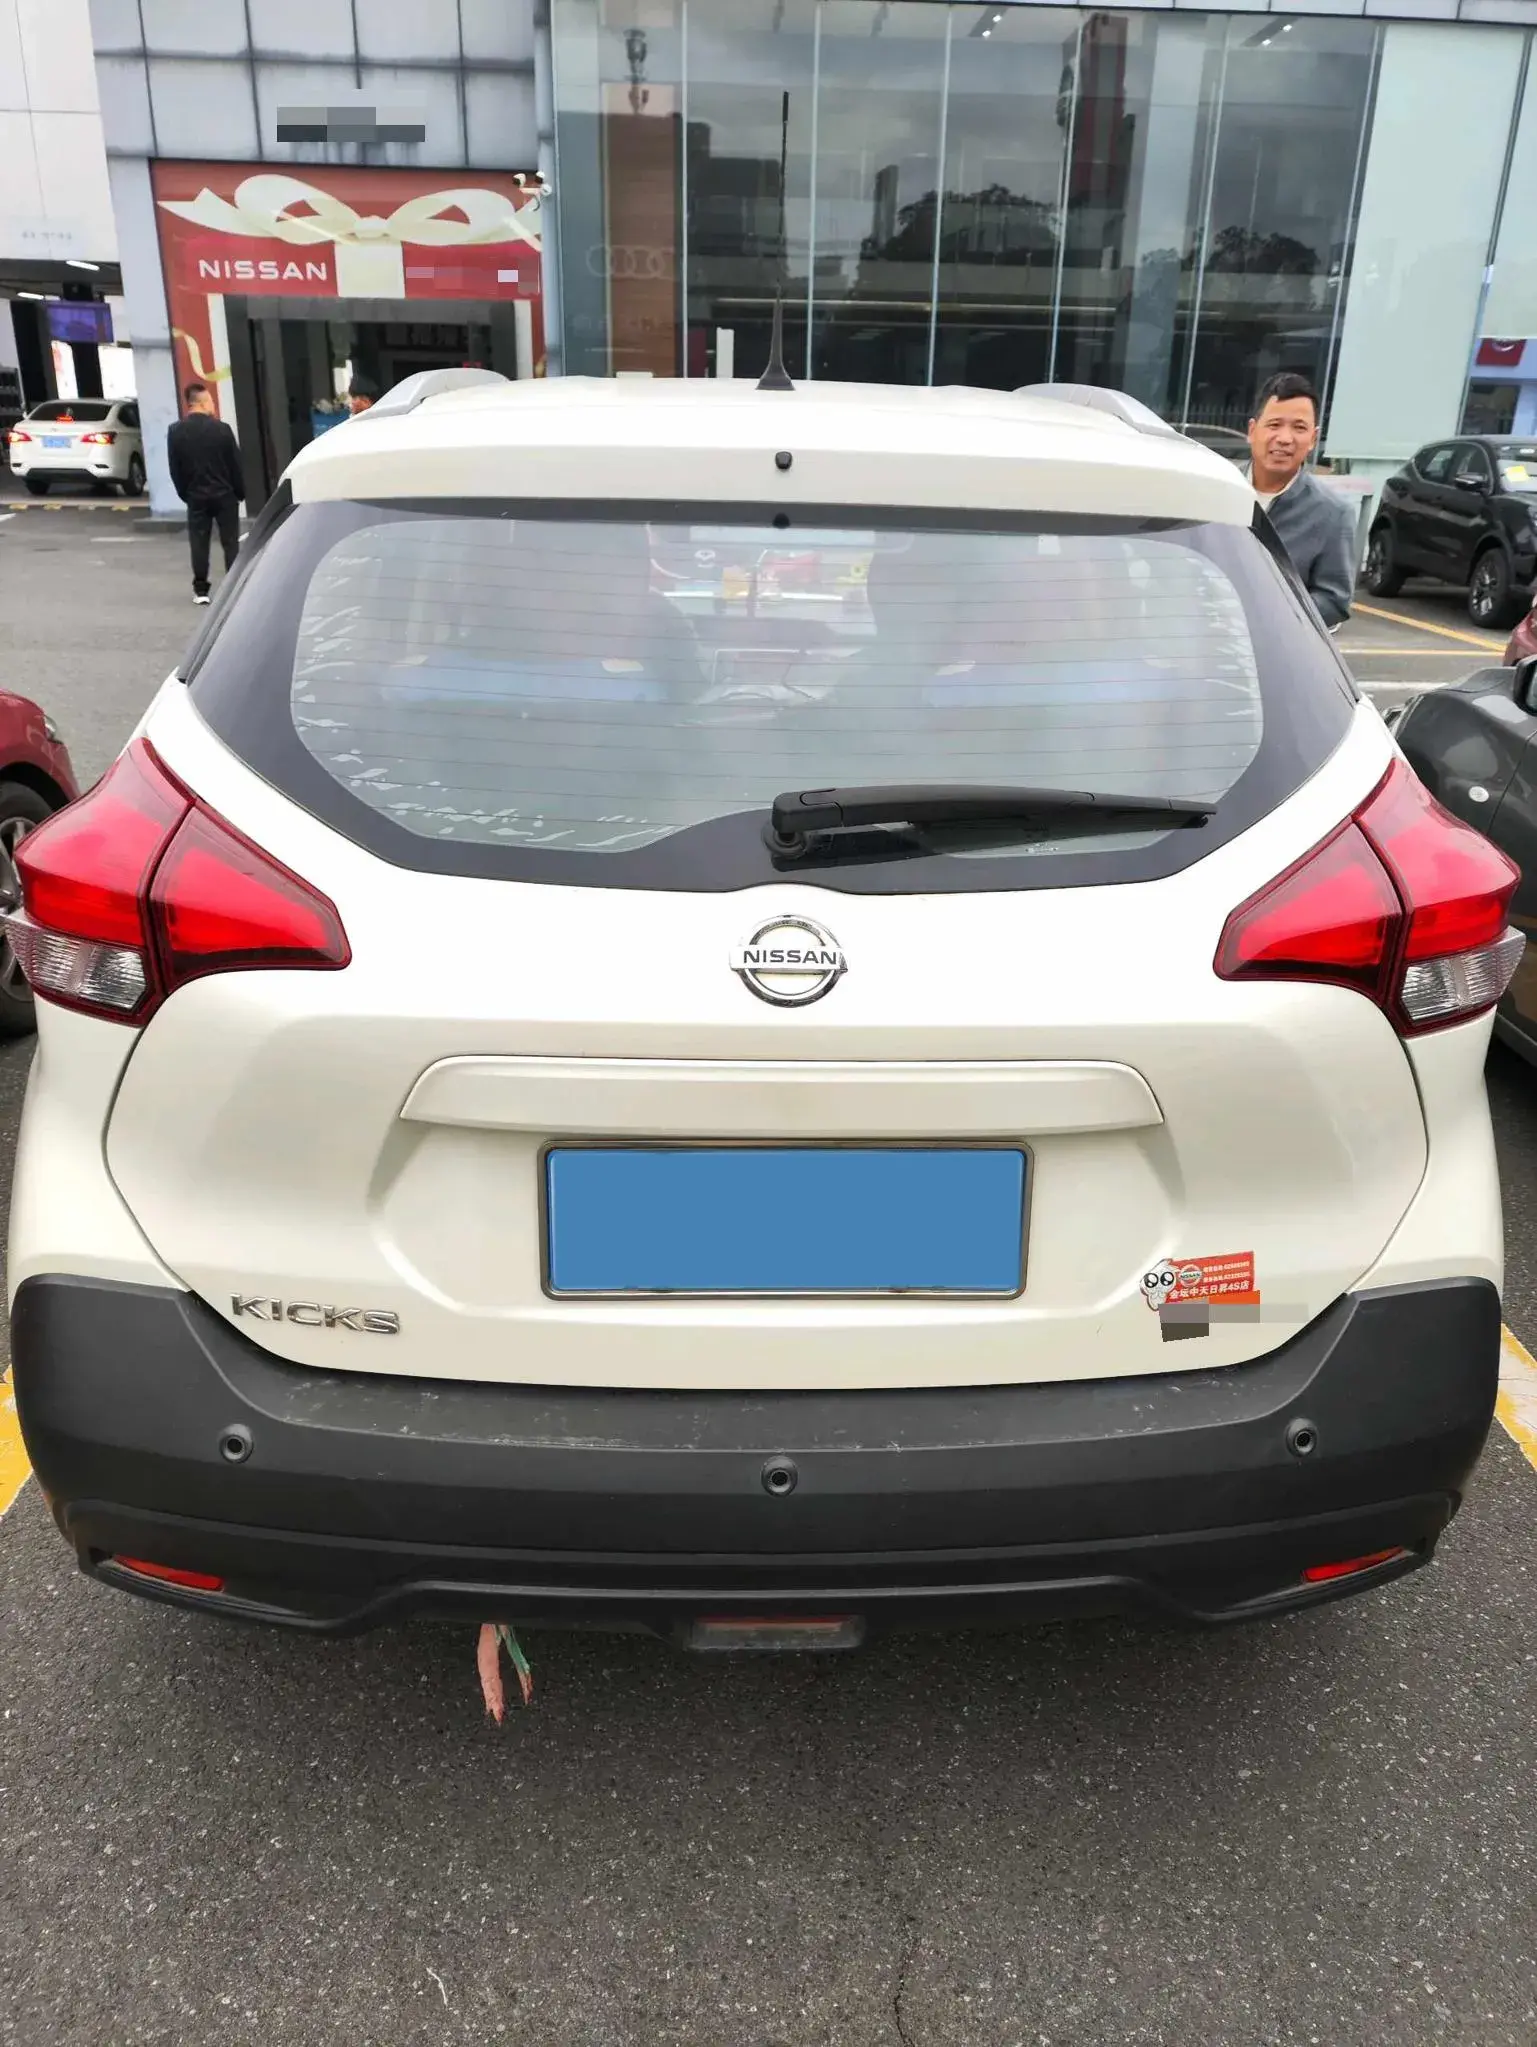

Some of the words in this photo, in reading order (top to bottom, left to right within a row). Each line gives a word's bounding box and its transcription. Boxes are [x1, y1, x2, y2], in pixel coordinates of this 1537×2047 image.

[198, 259, 327, 281] NISSAN
[743, 949, 837, 965] NISSAN
[230, 1292, 400, 1334] KICKS
